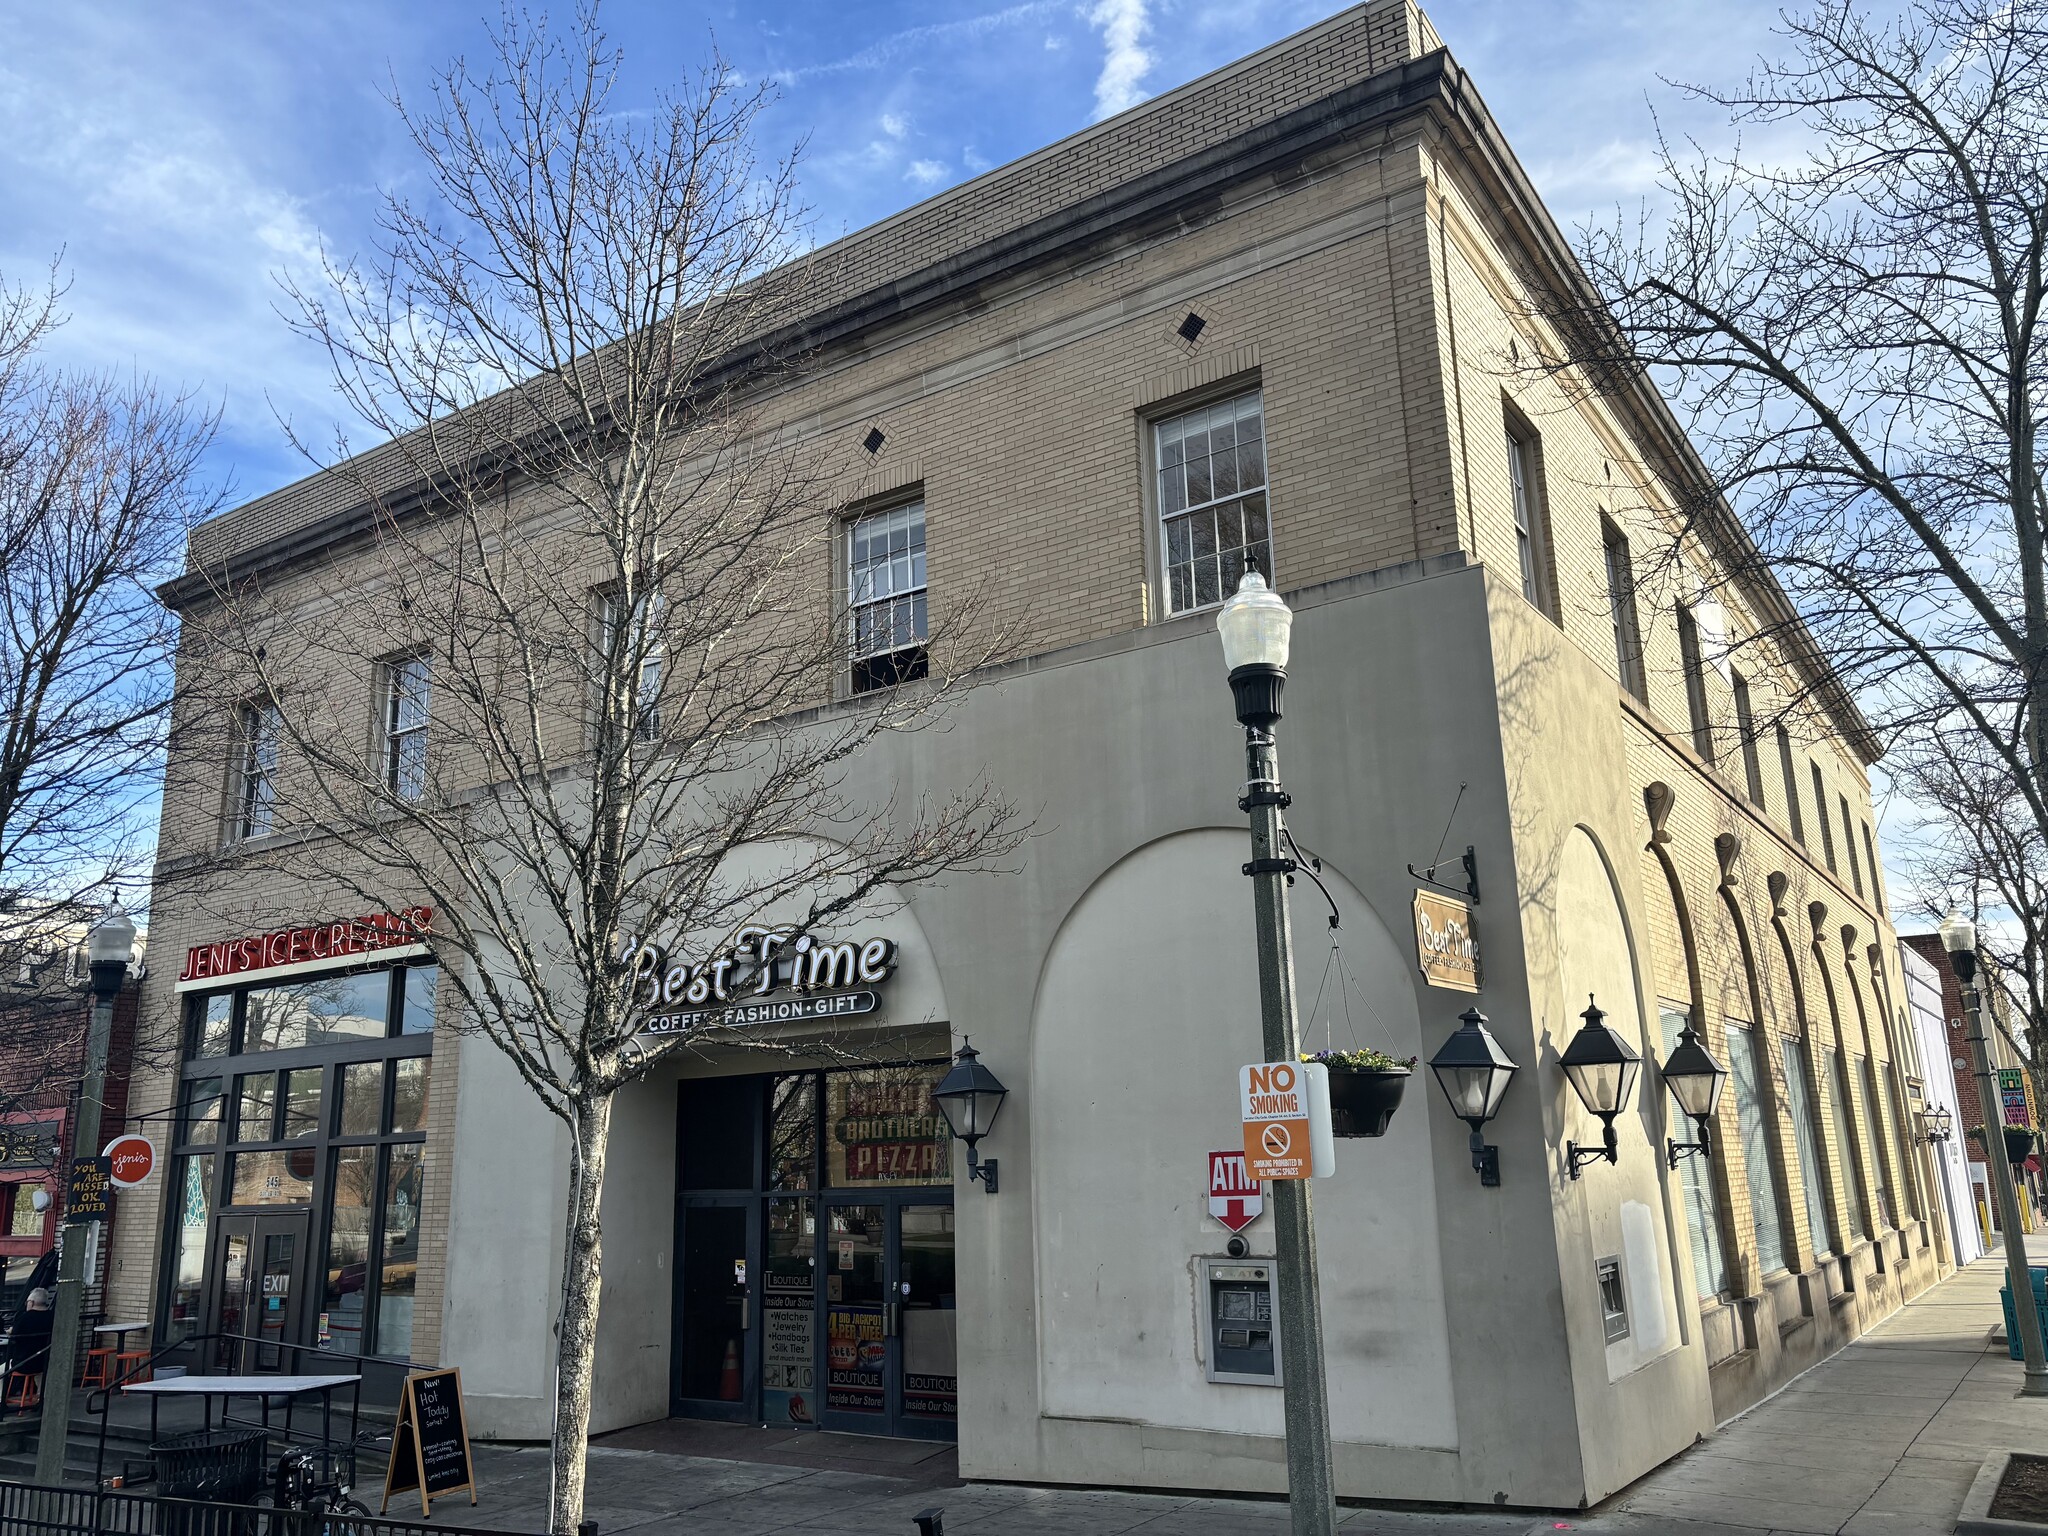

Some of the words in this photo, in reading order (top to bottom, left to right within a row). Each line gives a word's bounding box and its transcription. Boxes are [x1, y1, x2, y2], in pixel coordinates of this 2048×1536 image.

[1420, 906, 1450, 955] Best
[1446, 918, 1480, 961] Time
[180, 938, 255, 981] JENI'S
[262, 929, 304, 969] ICE
[311, 907, 430, 959] CREAMS
[621, 934, 733, 1009] Best
[735, 922, 892, 996] Time
[648, 1011, 711, 1032] COFFE
[724, 1003, 800, 1025] FASHION
[815, 995, 858, 1015] GIFT
[1249, 1064, 1296, 1094] NO
[1250, 1093, 1299, 1114] SMOKING
[2025, 1083, 2036, 1120] DOWNTOWN
[857, 1144, 937, 1172] PIZZA
[1253, 1159, 1272, 1168] SMOKING
[1272, 1158, 1297, 1167] PROHIBITED
[73, 1163, 97, 1176] YOU
[1212, 1155, 1258, 1190] ATM
[1258, 1168, 1266, 1177] ALL
[1266, 1168, 1282, 1177] PUBLIC
[1282, 1167, 1299, 1176] SPACES
[266, 1176, 278, 1188] 545
[263, 1274, 290, 1292] EXIT
[772, 1275, 809, 1285] BOUTIQUE
[764, 1297, 784, 1307] Inside
[784, 1297, 797, 1307] Our
[773, 1311, 809, 1322] Watches
[775, 1322, 806, 1334] Jewelry
[828, 1312, 838, 1338] 4
[838, 1312, 851, 1324] BIG
[838, 1323, 856, 1339] PER
[771, 1332, 810, 1344] Handbags
[774, 1343, 788, 1353] Silk
[790, 1344, 805, 1354] Ties
[833, 1371, 879, 1385] BOUTIQUE
[909, 1376, 957, 1391] BOUTIQUE
[420, 1390, 438, 1407] Hot
[828, 1393, 848, 1404] Inside
[849, 1394, 862, 1405] Our
[863, 1395, 884, 1407] Store!
[905, 1399, 926, 1411] Inside
[927, 1400, 941, 1412] Our
[424, 1405, 449, 1420] Toddy
